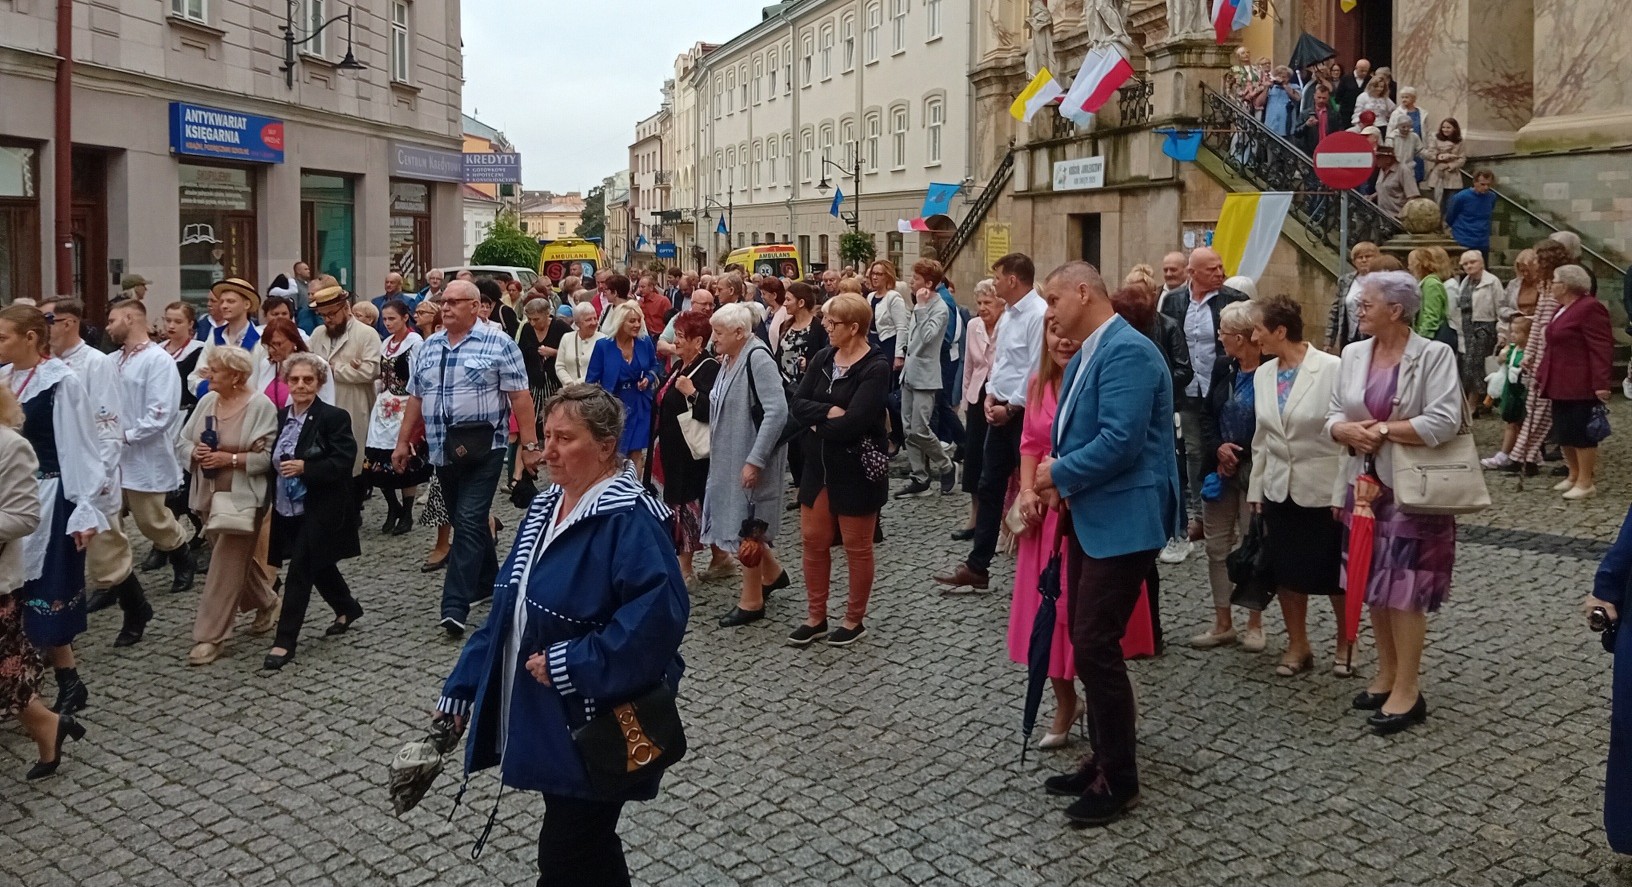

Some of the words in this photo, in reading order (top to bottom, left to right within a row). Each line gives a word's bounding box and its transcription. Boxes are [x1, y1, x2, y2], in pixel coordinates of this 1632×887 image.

[185, 108, 247, 129] ANTYKWARIAT
[185, 124, 240, 144] KSIĘGARNIA
[466, 154, 517, 165] KREDYTY
